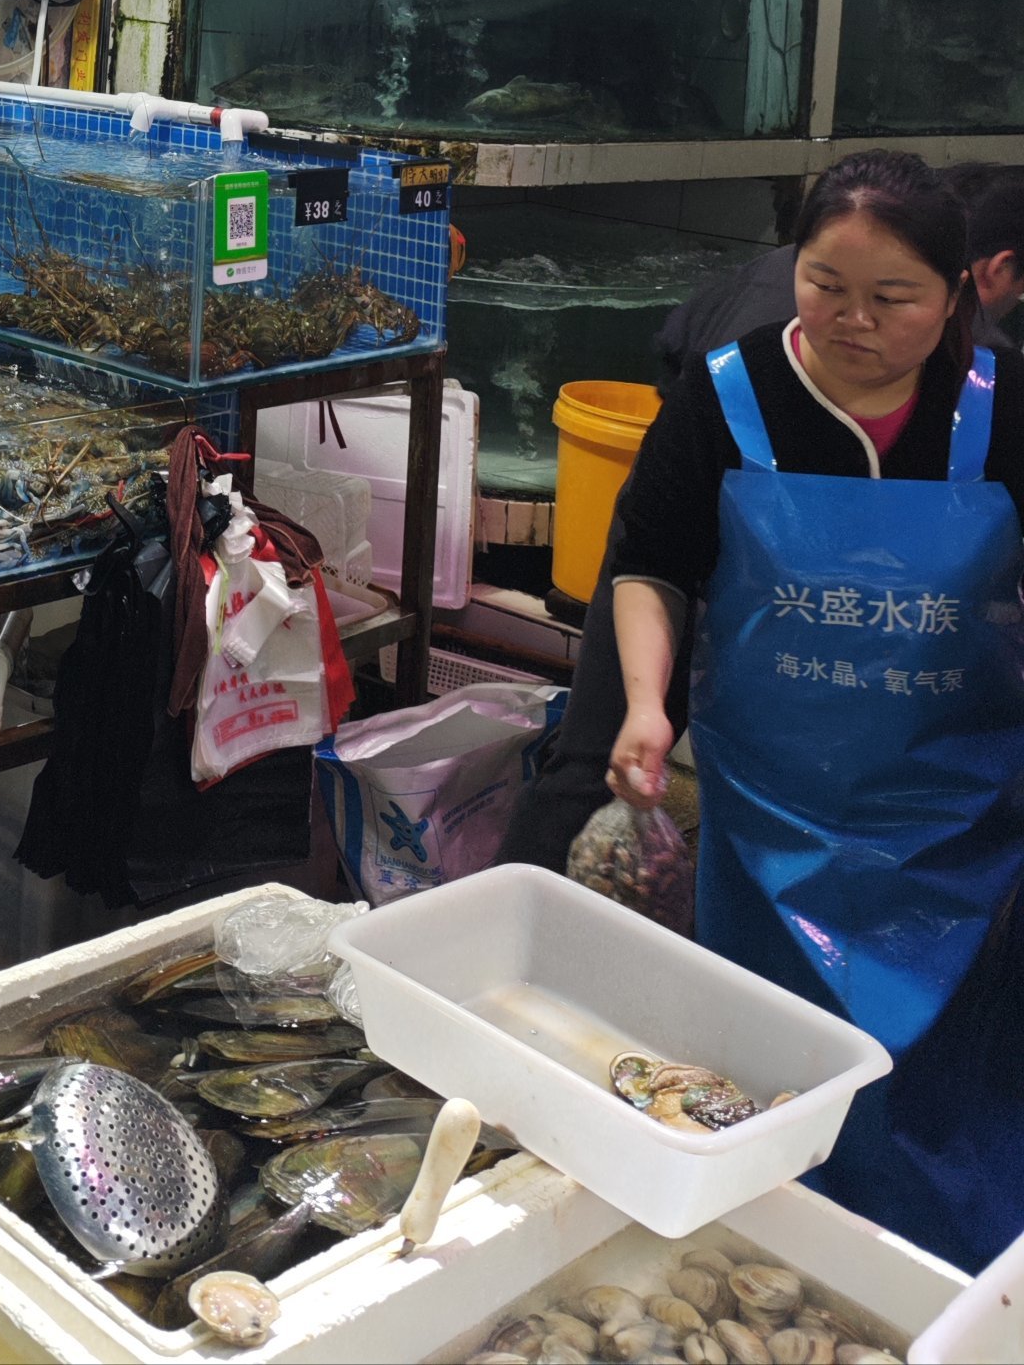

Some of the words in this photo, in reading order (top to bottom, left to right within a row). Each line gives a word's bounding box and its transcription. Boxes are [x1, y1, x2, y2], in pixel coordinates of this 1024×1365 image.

[75, 10, 93, 90] 利发门业
[773, 584, 961, 635] 兴盛水族
[775, 651, 965, 696] 海水晶、氧气泵
